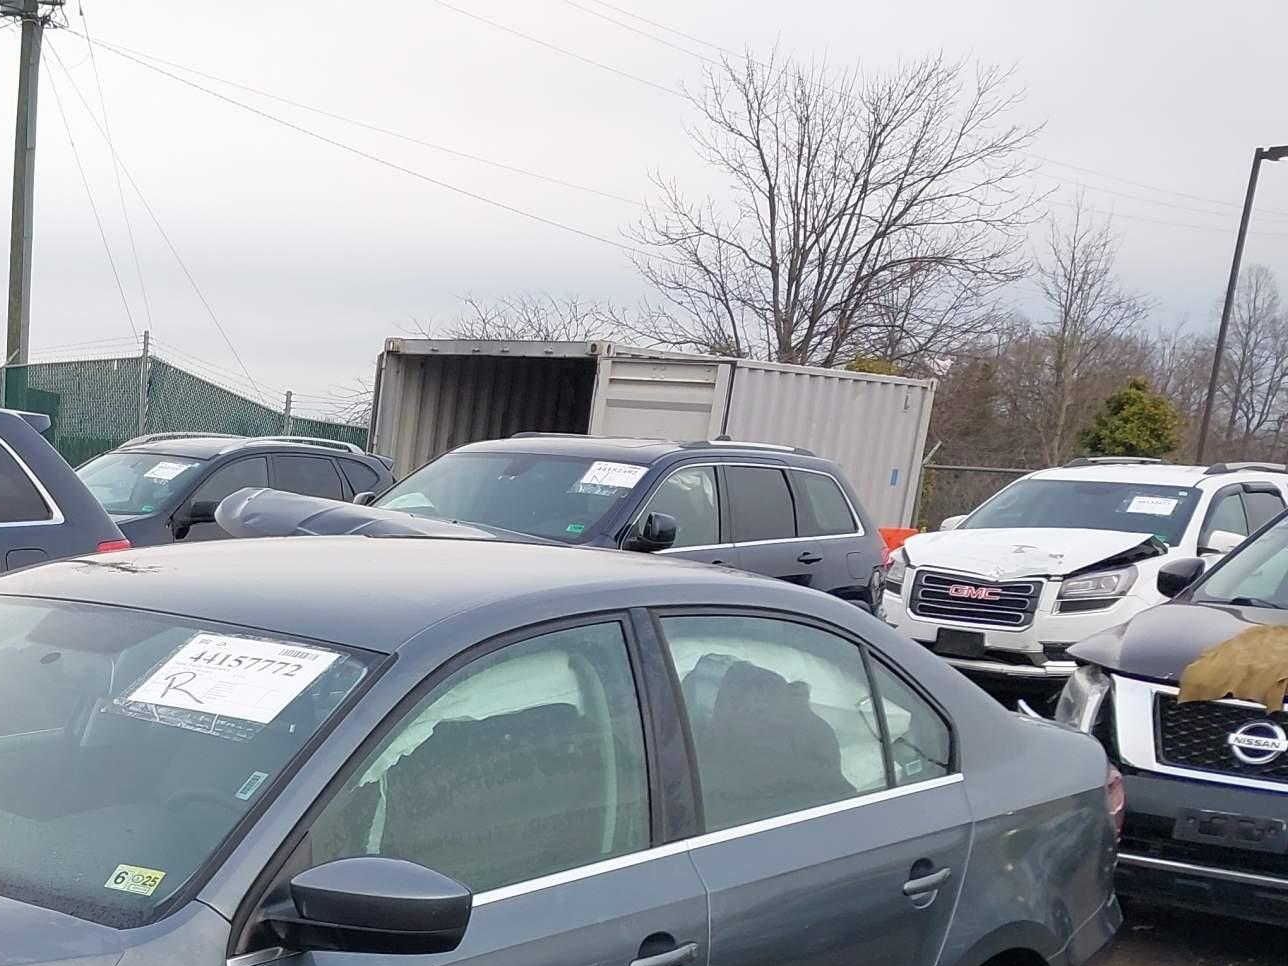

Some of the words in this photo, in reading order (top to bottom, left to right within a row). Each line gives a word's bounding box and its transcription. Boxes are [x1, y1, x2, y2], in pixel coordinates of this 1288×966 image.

[949, 584, 1003, 601] GMC
[189, 650, 304, 677] 44157772
[160, 671, 205, 704] R
[1233, 736, 1281, 749] NISSAN
[113, 871, 129, 885] 6
[141, 875, 160, 888] 25
